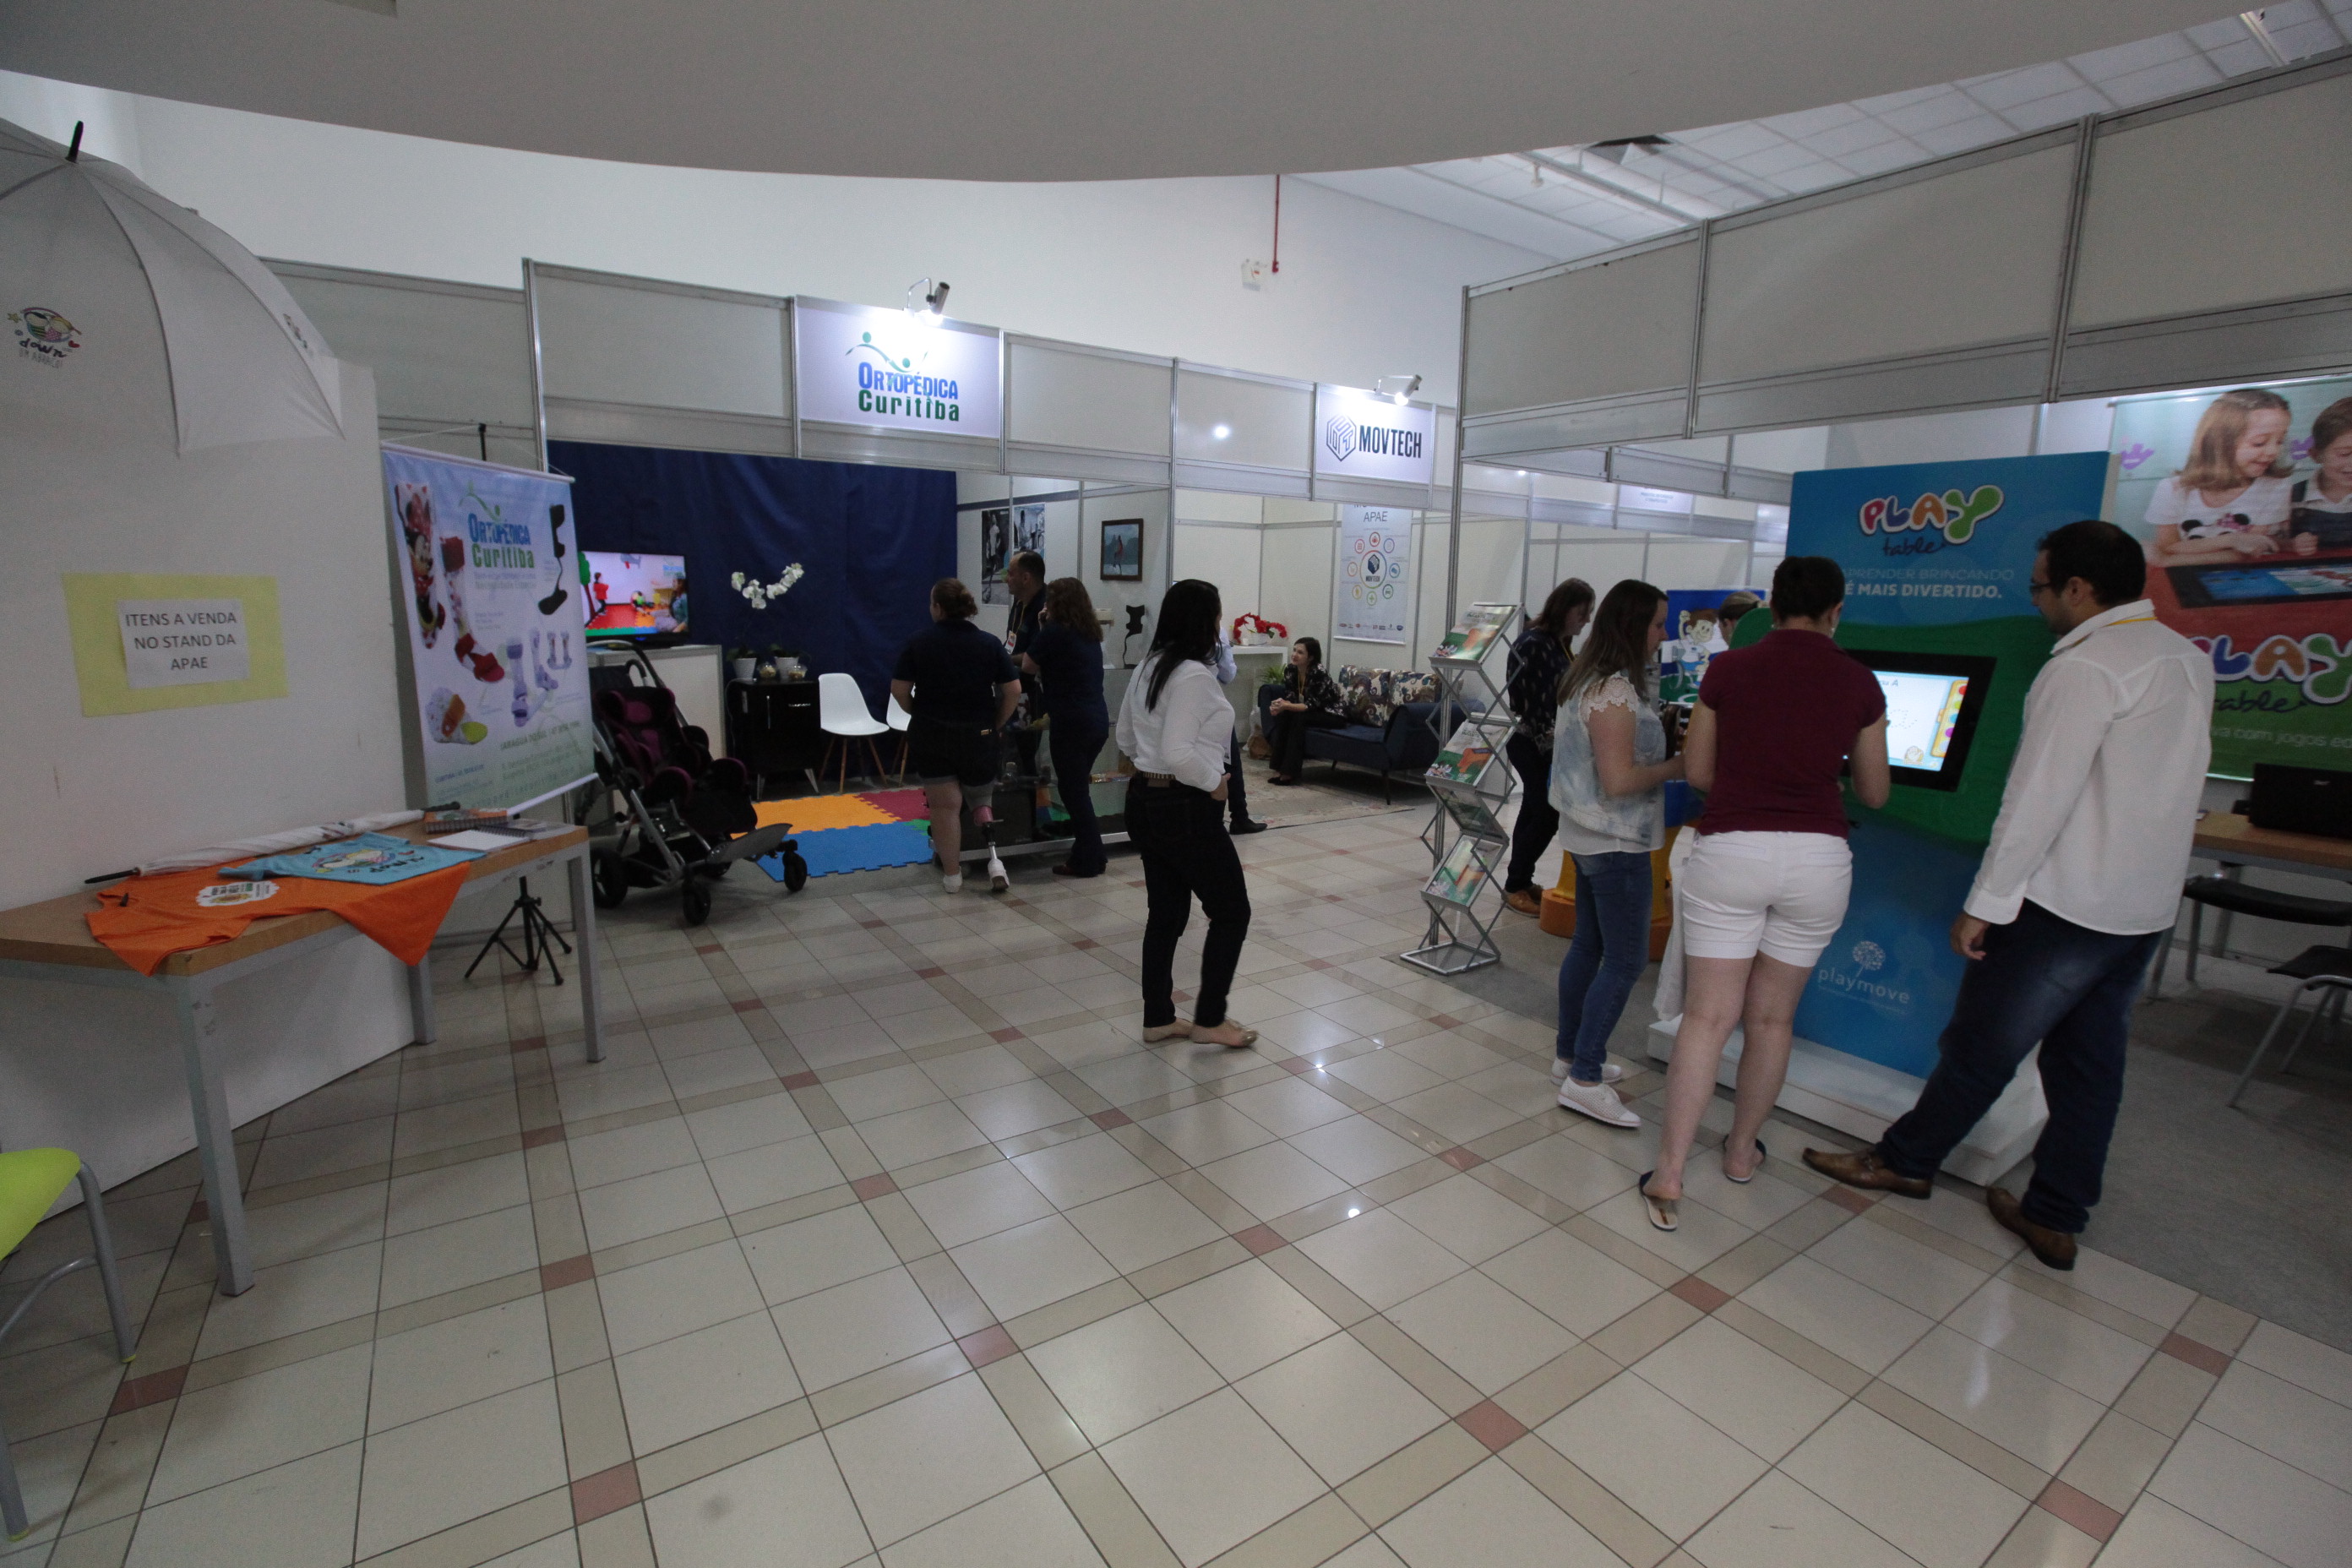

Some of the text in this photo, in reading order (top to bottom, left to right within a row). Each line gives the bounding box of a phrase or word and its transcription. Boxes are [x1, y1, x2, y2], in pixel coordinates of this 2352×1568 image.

[19, 338, 68, 357] down
[858, 362, 959, 400] ORTOPÉDICA
[858, 389, 960, 422] Curitiba
[1358, 424, 1422, 459] MOVTECH
[1363, 510, 1388, 522] APAE
[1859, 484, 2005, 544] PLAY
[471, 542, 535, 569] Curitiba
[1882, 536, 1946, 557] table
[1919, 569, 2015, 581] BRINCANDO
[1858, 583, 1898, 596] MAIS
[1901, 583, 2003, 599] DIVERTIDO.
[125, 612, 237, 627] ITENS A VENDA
[133, 634, 237, 650] NO STAND DA
[170, 656, 209, 671] APAE
[2213, 689, 2308, 714] able
[2233, 728, 2273, 741] com
[2276, 732, 2328, 747] jogos
[1817, 966, 1910, 1004] playmove
